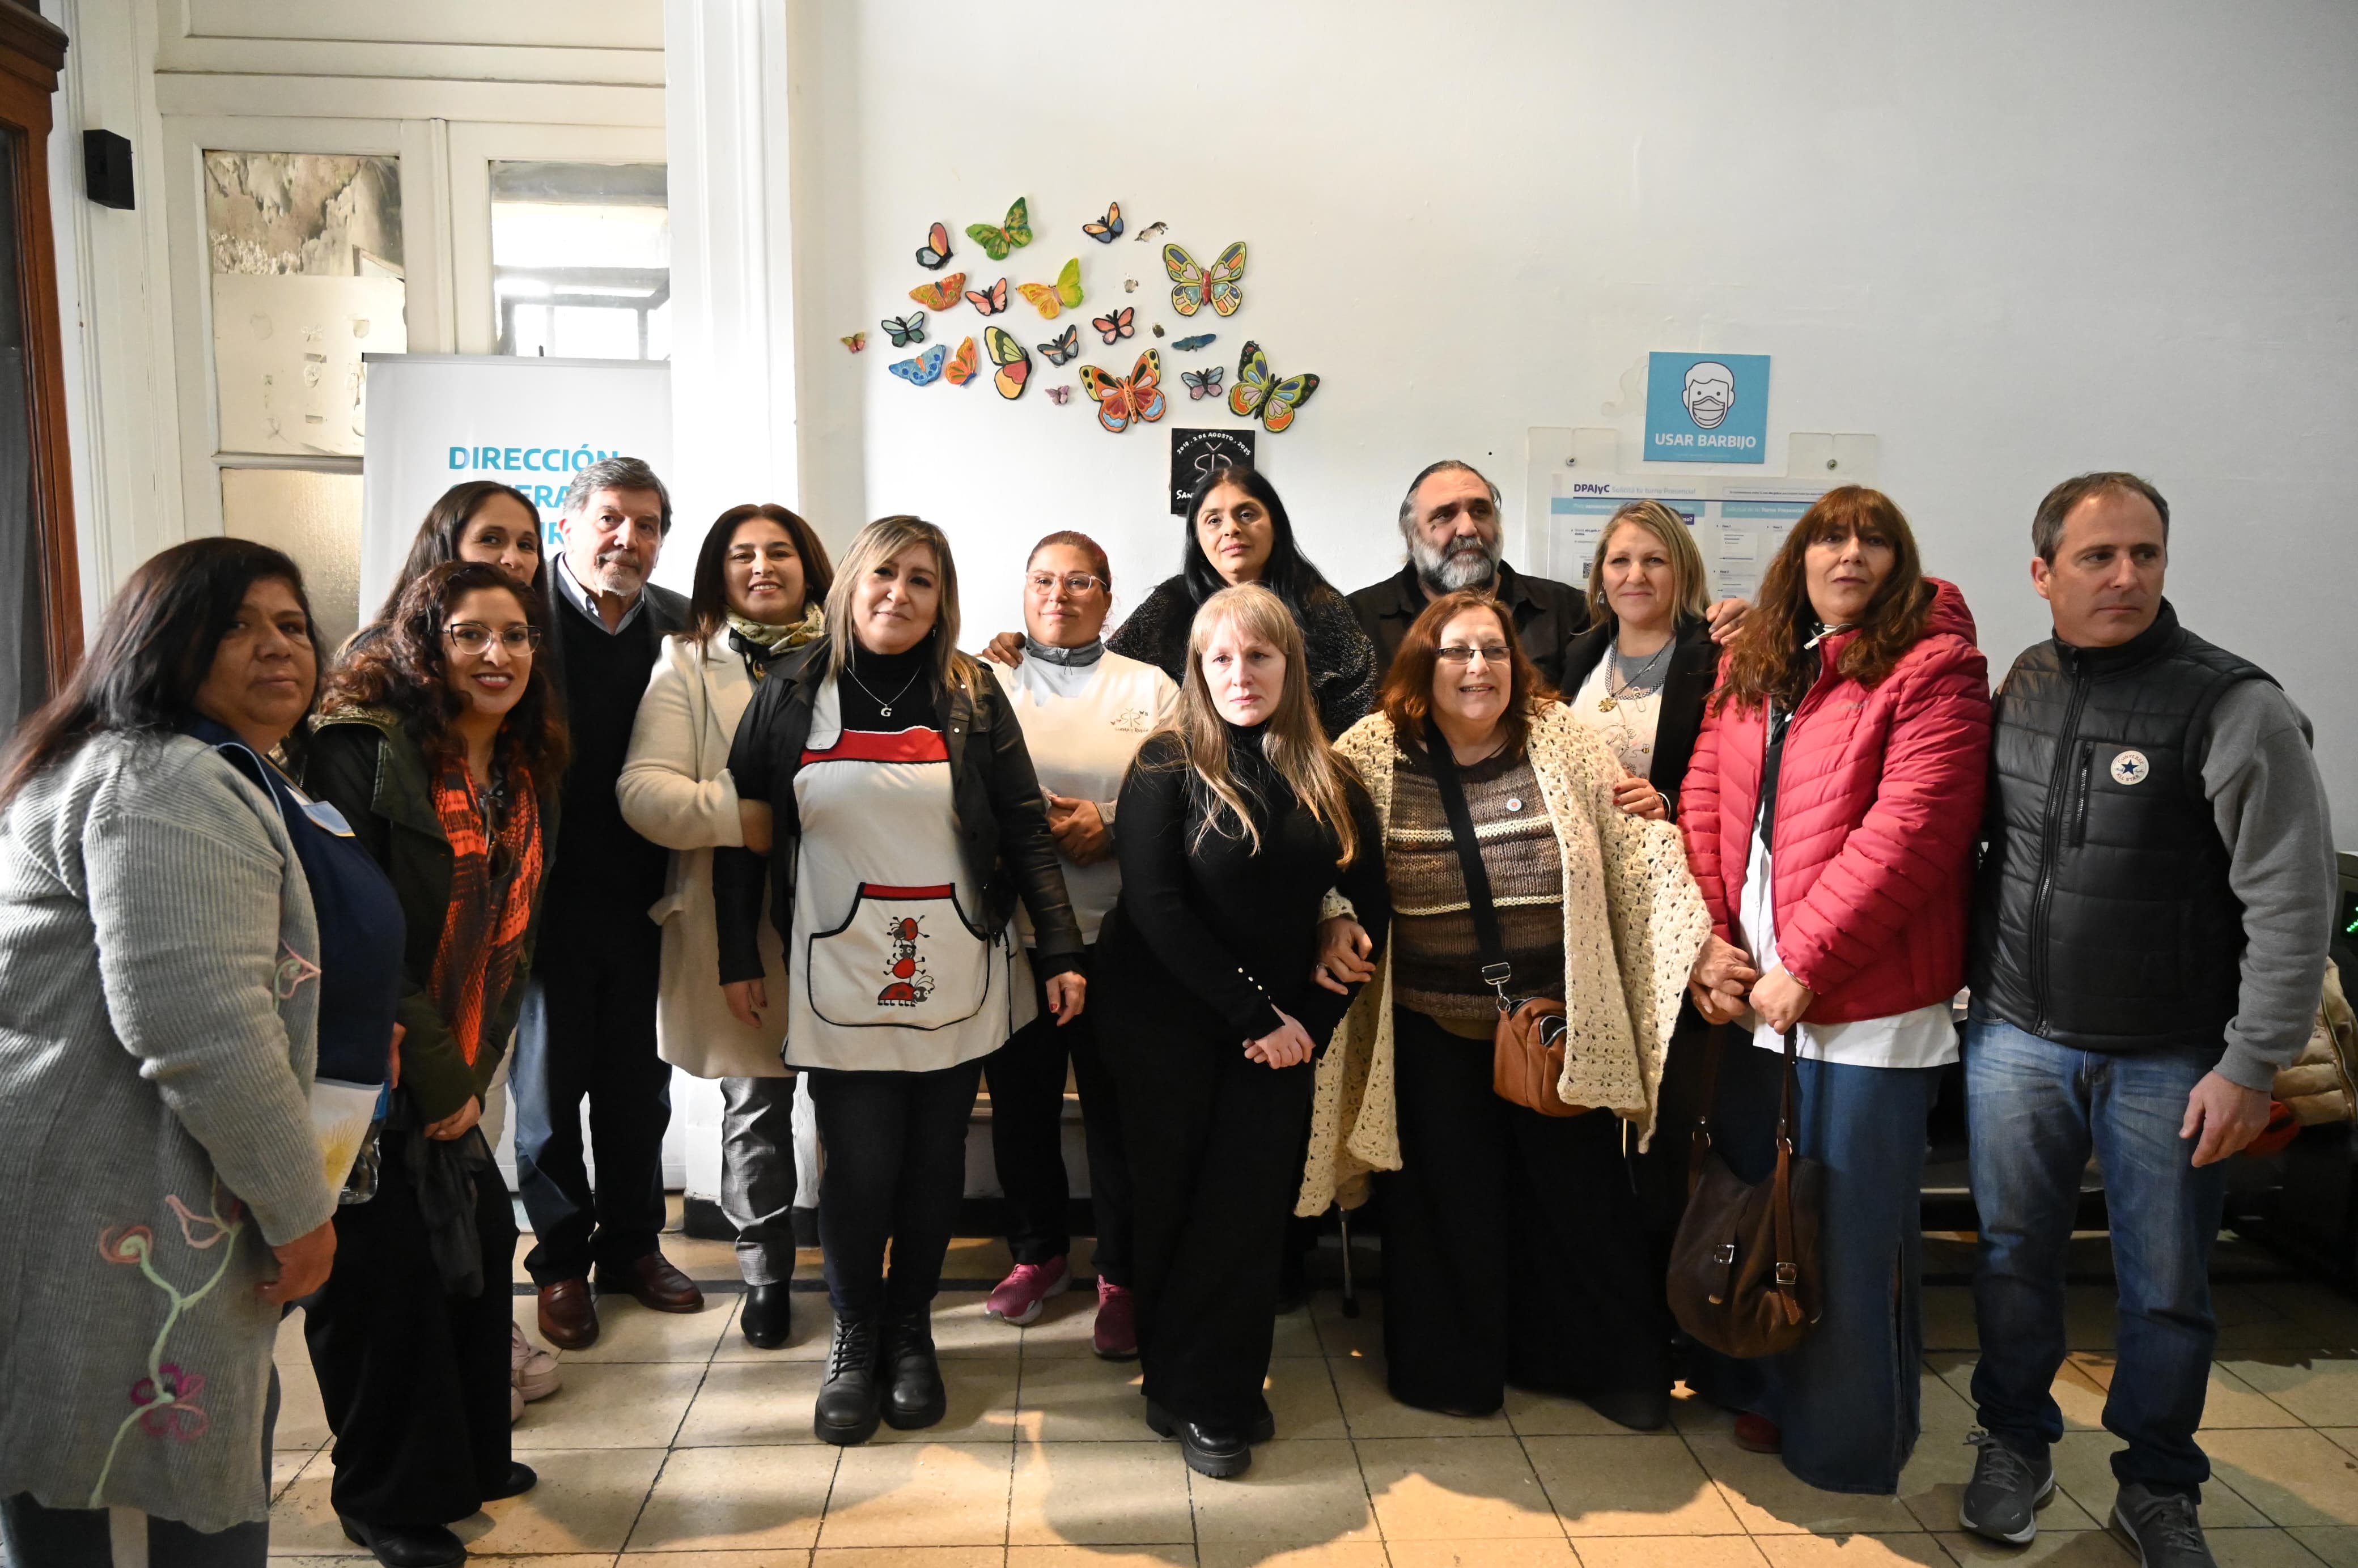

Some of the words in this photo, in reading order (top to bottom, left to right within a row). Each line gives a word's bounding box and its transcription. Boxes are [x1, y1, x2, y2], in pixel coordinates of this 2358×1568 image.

[1208, 432, 1233, 441] AGOSTO
[1237, 441, 1251, 456] 2025
[1655, 433, 1694, 447] USAR
[1698, 434, 1757, 450] BARBIJO
[1176, 489, 1193, 500] SAN
[1574, 484, 1610, 495] DPAJyC
[880, 707, 892, 717] G
[2118, 754, 2144, 765] CONVERSE
